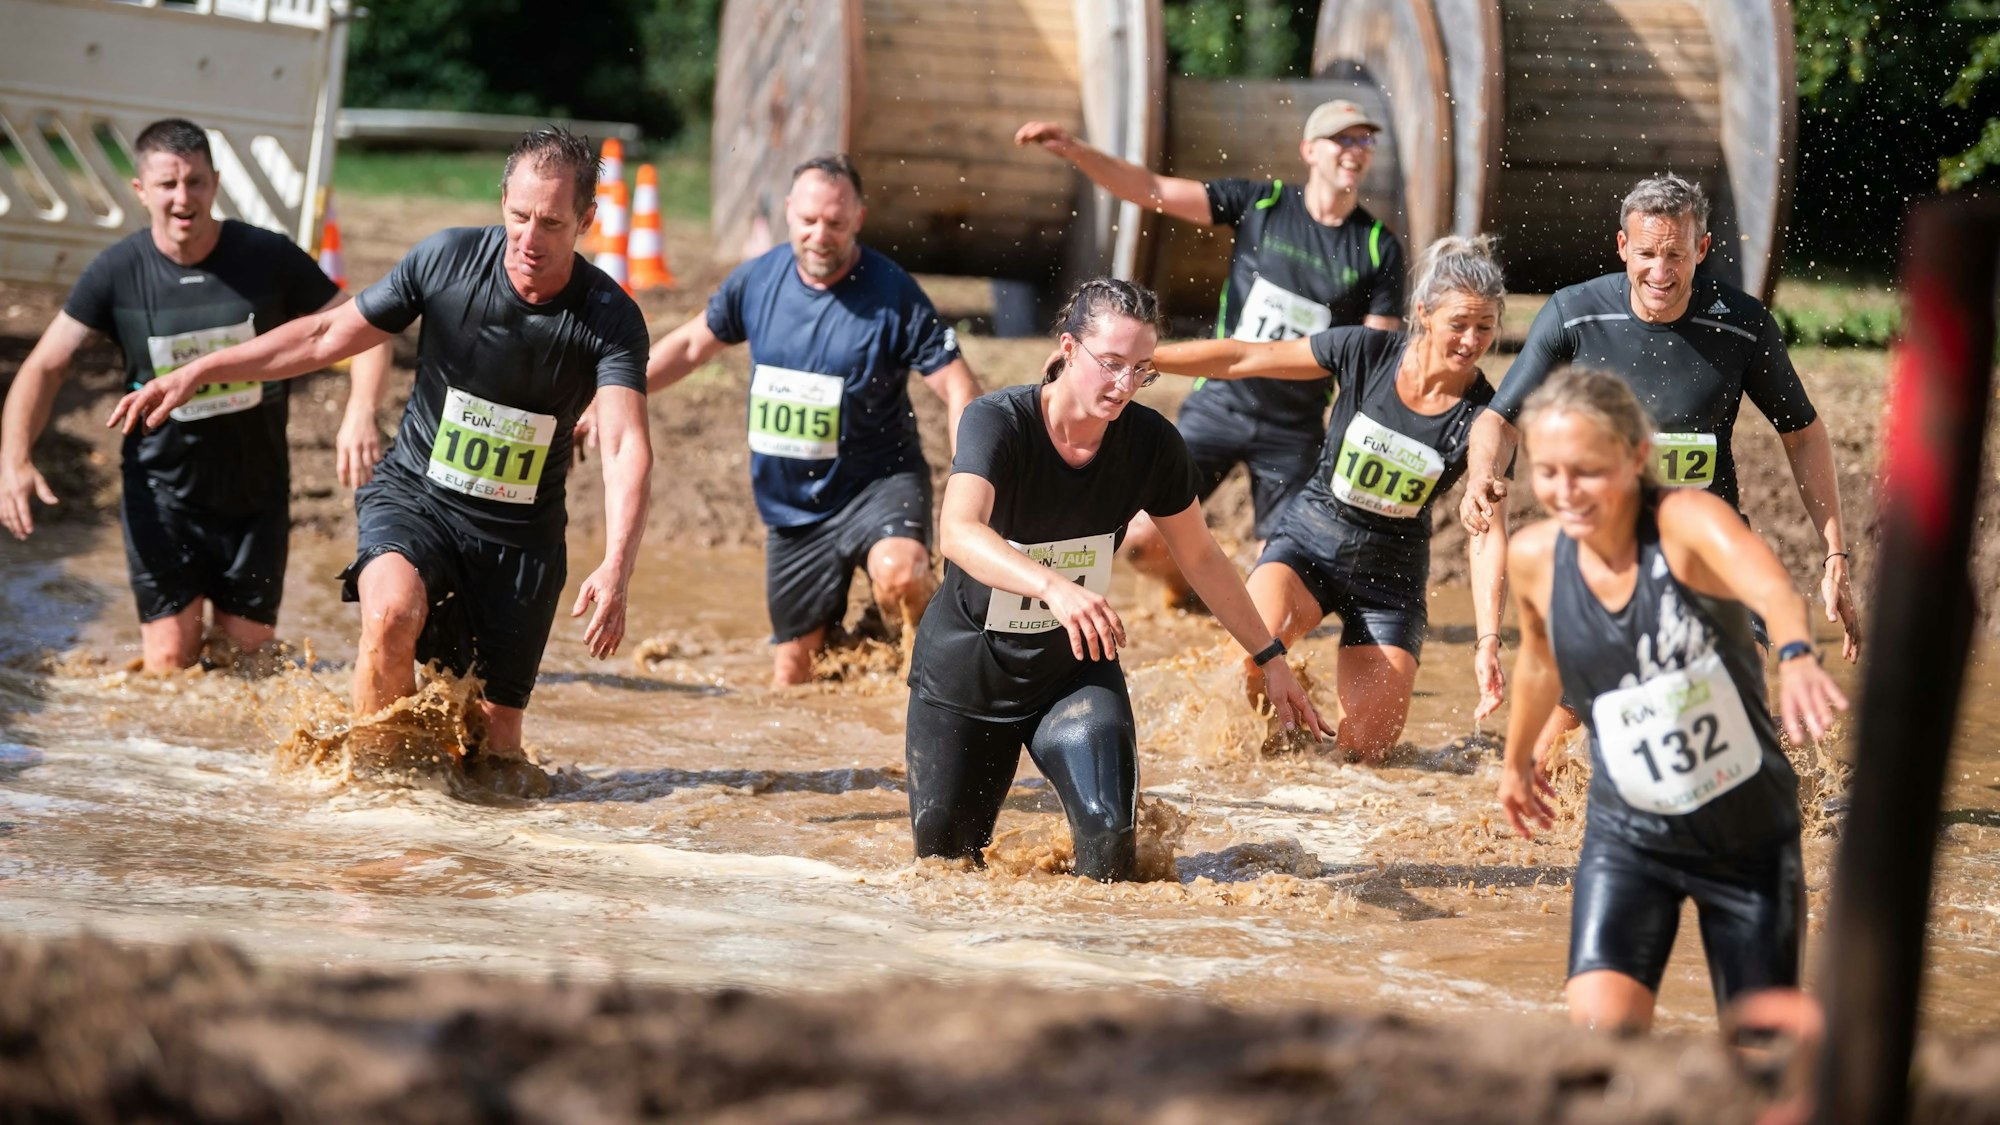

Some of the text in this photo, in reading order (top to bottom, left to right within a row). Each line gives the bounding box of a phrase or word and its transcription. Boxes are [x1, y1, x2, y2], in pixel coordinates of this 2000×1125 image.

[758, 402, 831, 438] 1015
[446, 430, 536, 481] 1011
[1347, 451, 1427, 503] 1013
[445, 473, 518, 499] EUGEBAU
[1009, 619, 1060, 630] EUGEB
[1633, 714, 1729, 783] 132
